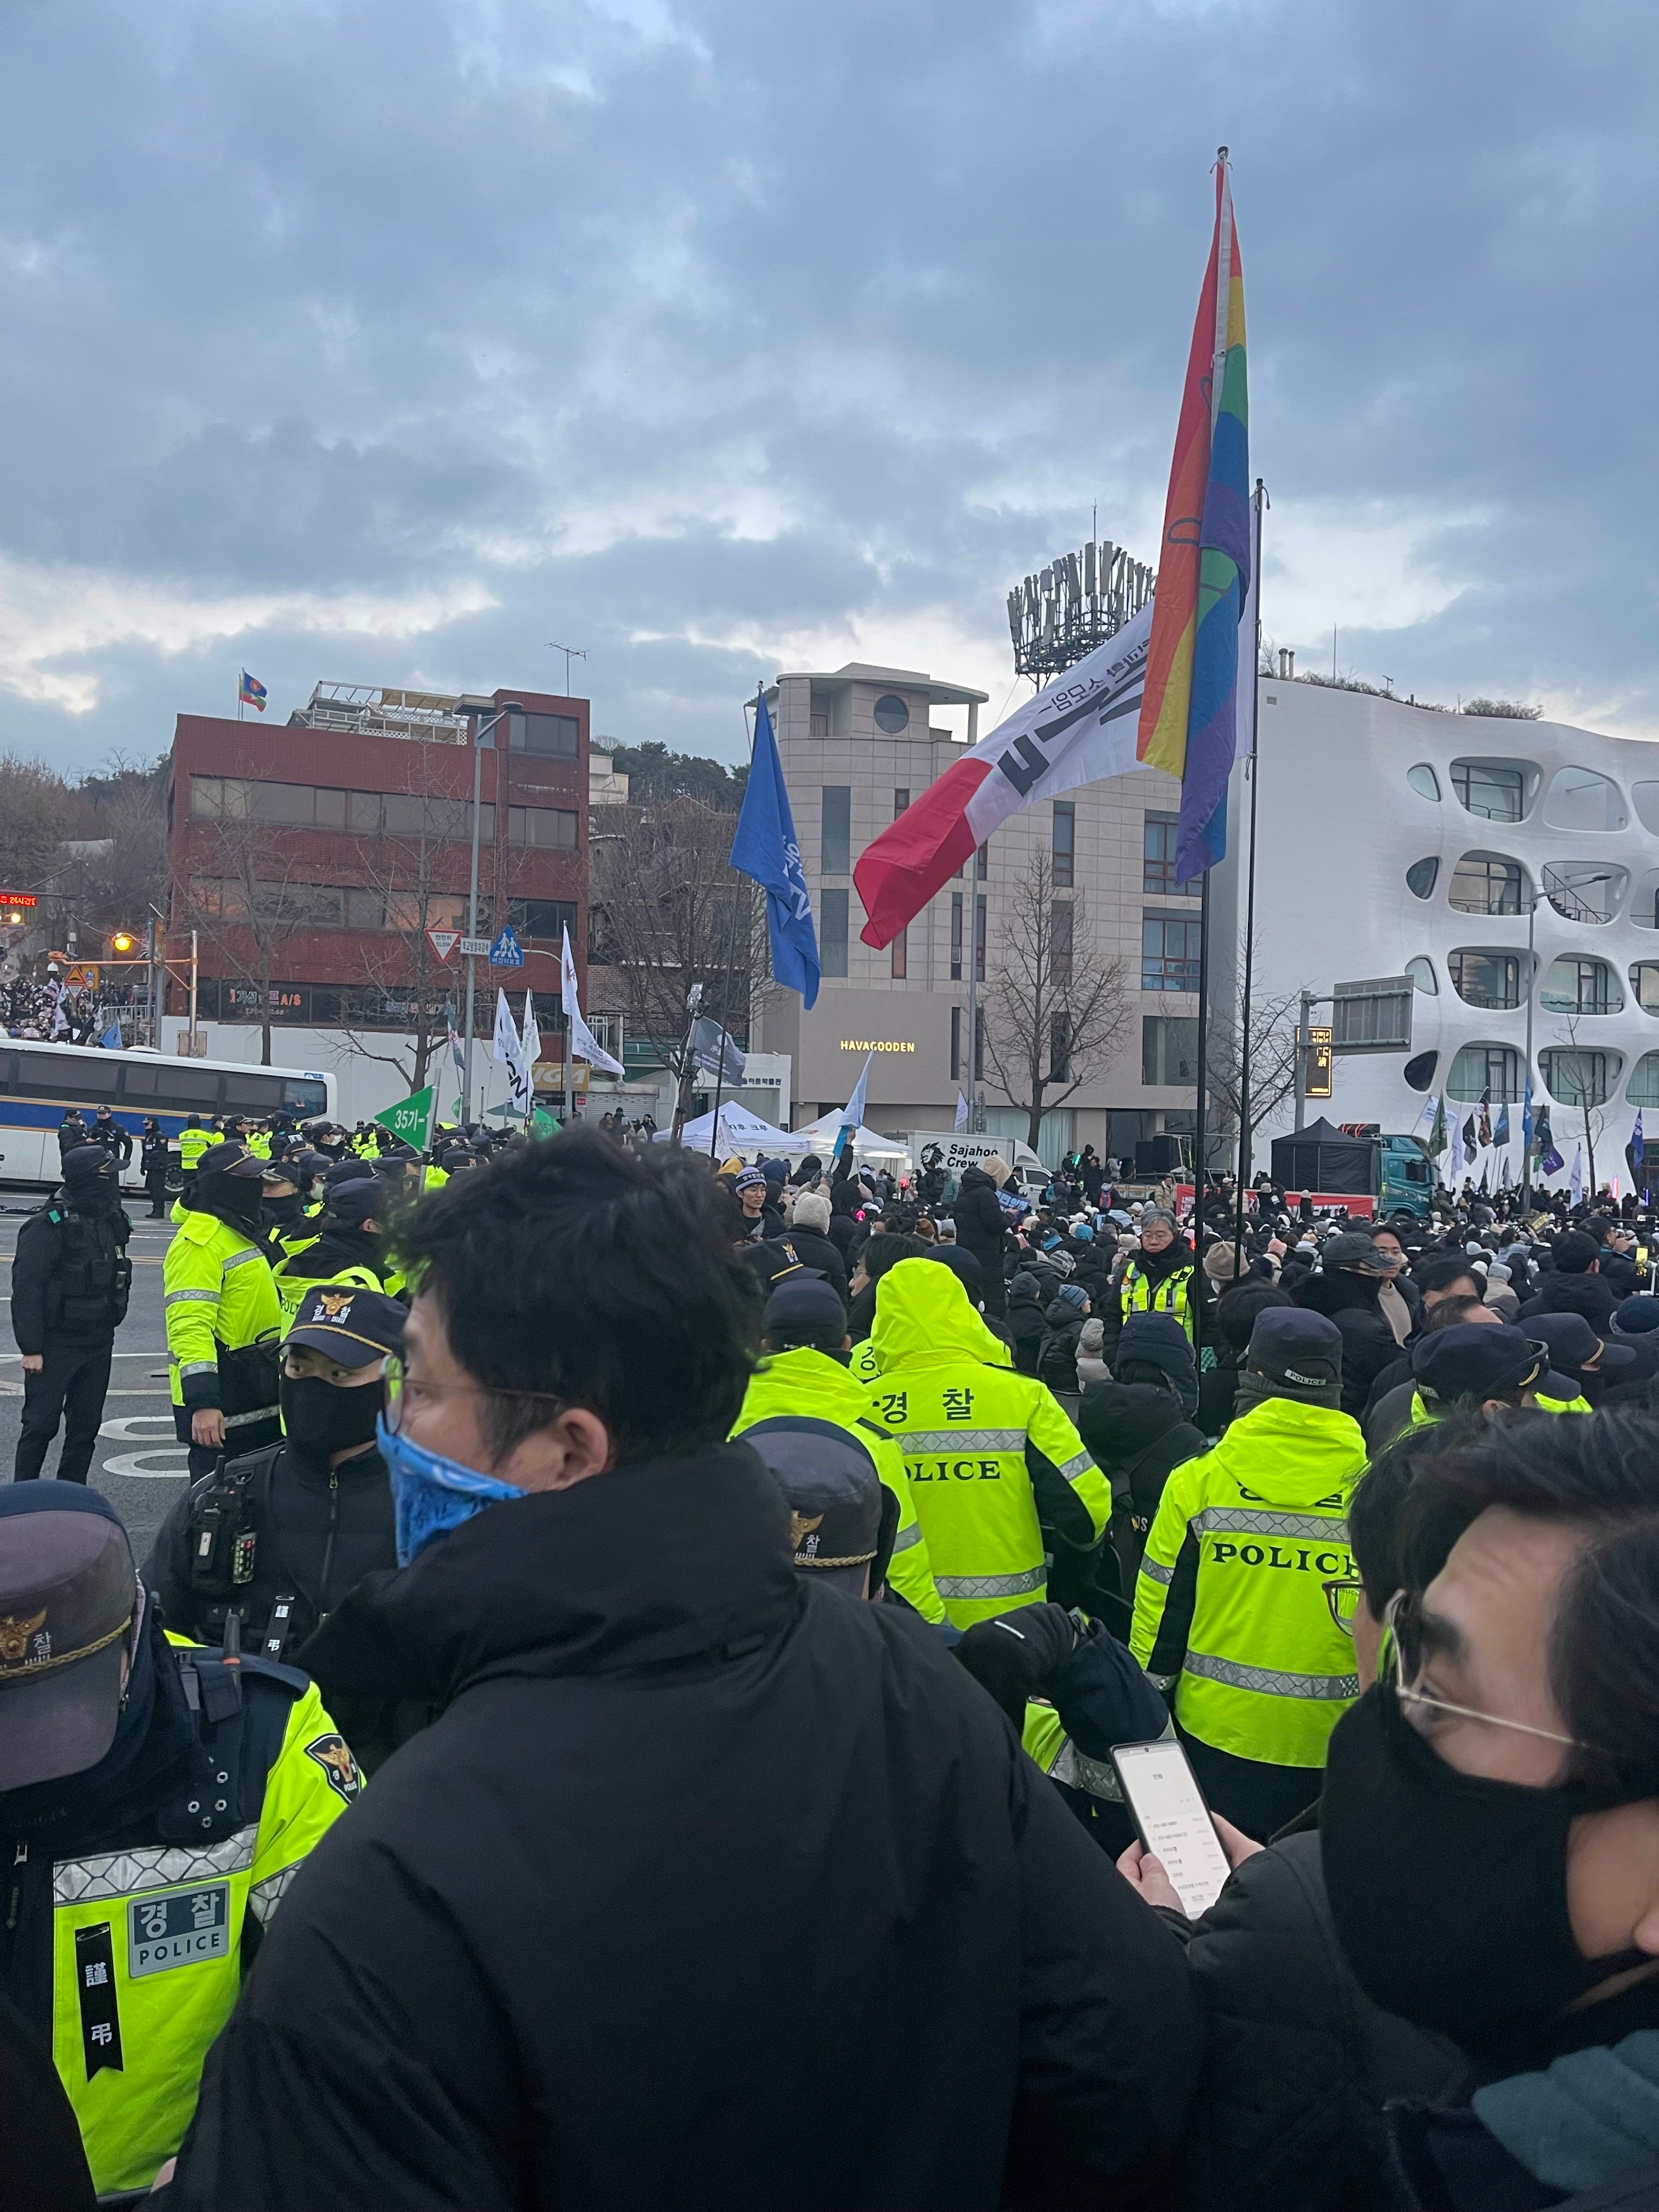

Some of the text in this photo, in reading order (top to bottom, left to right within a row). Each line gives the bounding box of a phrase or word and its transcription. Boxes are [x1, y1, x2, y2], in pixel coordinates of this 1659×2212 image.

[840, 1040, 915, 1052] HAVAGOODEN
[394, 1109, 427, 1131] 35기-
[949, 1144, 998, 1158] Sajahoo
[947, 1157, 979, 1168] Crew
[33, 1631, 52, 1655] 찰
[139, 1933, 221, 1966] POLICE
